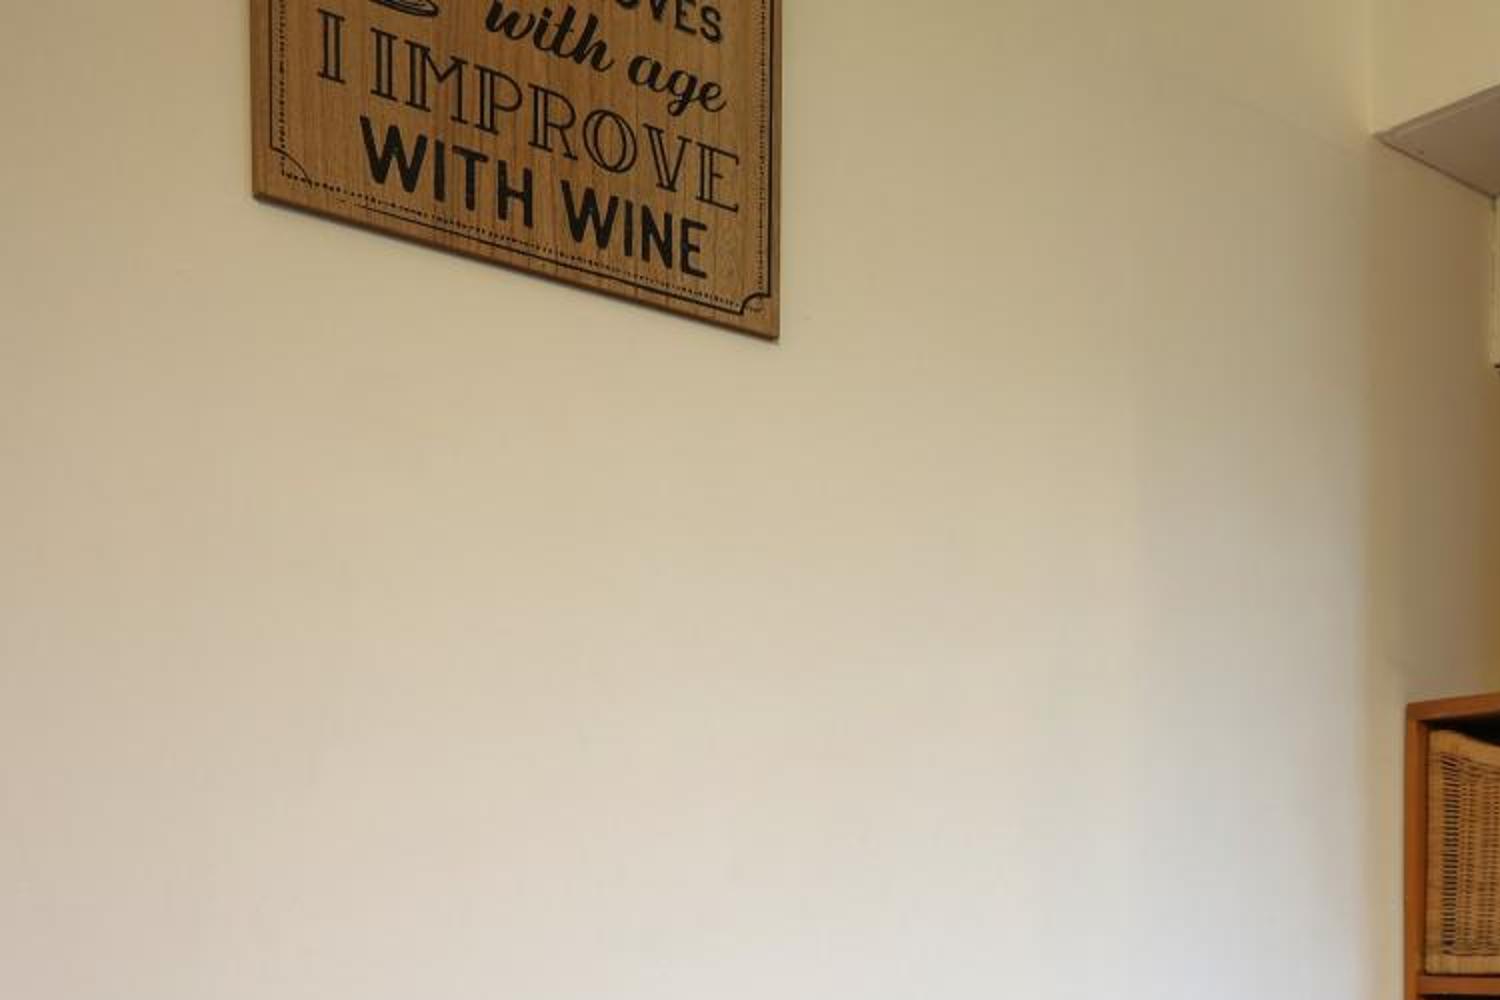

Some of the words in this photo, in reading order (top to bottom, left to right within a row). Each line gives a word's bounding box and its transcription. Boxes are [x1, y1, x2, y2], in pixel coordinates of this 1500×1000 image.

[485, 0, 615, 73] with
[628, 55, 727, 117] age
[616, 0, 722, 43] VES
[317, 7, 346, 84] I
[370, 27, 739, 213] IMPROVE
[360, 114, 533, 229] WITH
[560, 179, 708, 279] WINE
